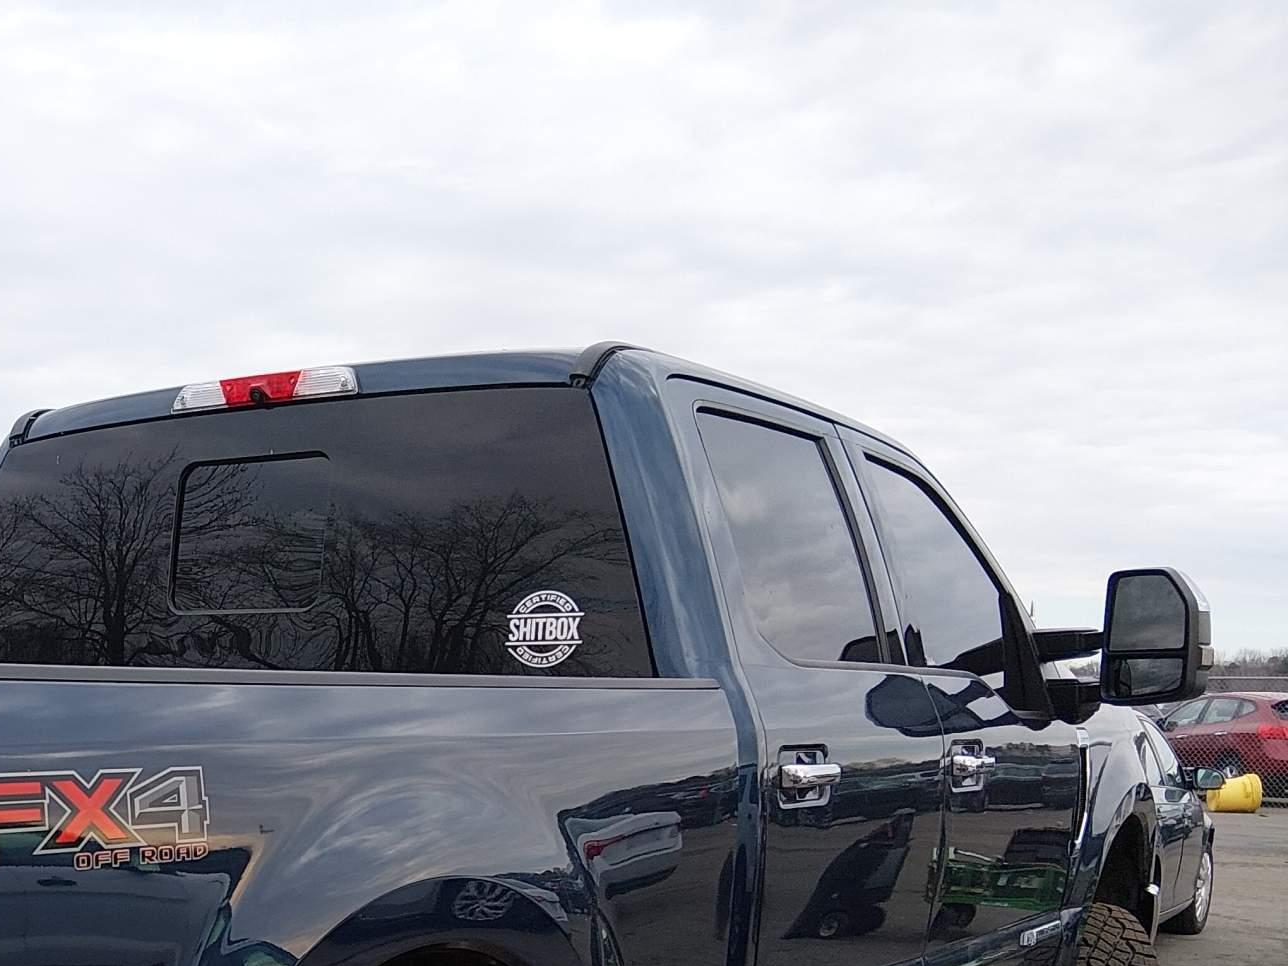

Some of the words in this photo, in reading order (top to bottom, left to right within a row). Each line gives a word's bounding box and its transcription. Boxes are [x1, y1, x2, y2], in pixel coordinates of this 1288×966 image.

[518, 593, 574, 614] CERTIFIED
[508, 617, 581, 642] SHITBOX
[516, 645, 570, 665] CERTIFIED
[74, 848, 130, 871] OFF
[139, 843, 209, 865] ROAD
